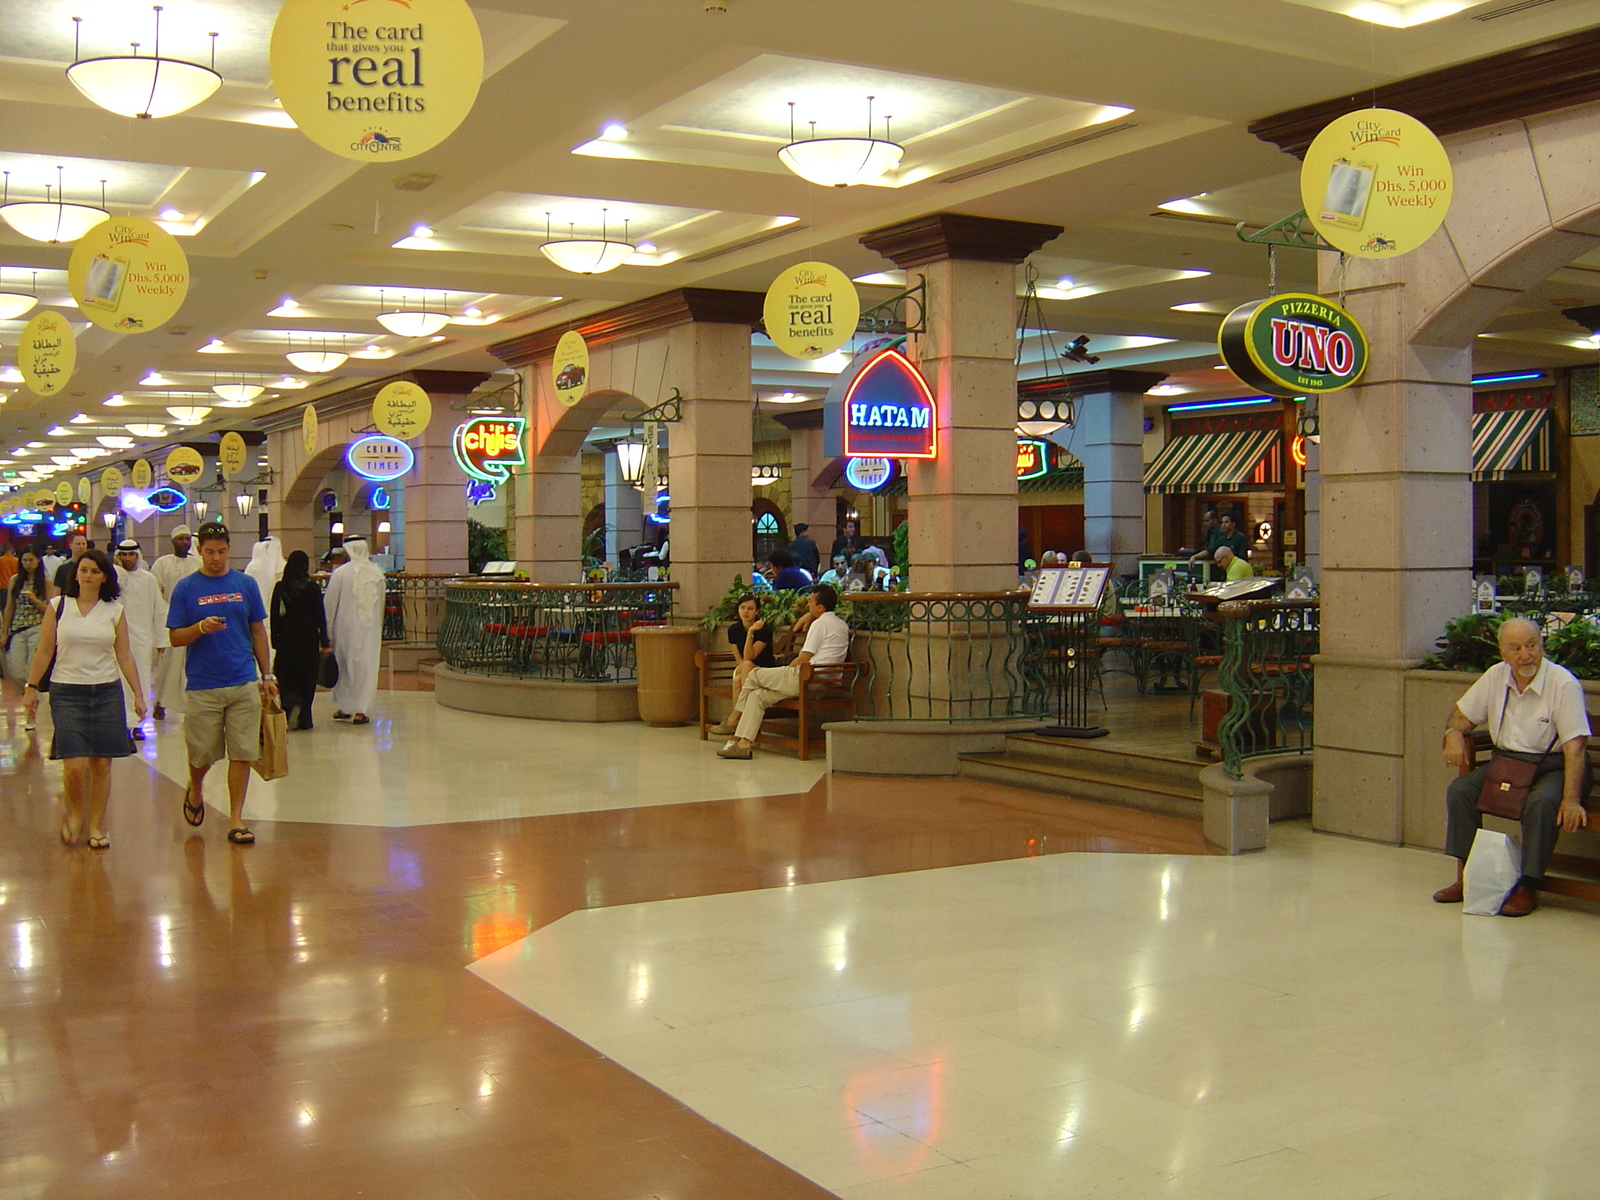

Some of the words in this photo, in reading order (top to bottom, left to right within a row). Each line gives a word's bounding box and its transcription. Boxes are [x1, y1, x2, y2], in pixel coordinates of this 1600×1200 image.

[326, 21, 367, 40] The
[375, 23, 423, 41] card
[326, 42, 349, 51] that
[352, 42, 380, 53] gives
[383, 44, 403, 54] you
[328, 47, 424, 86] real
[326, 91, 425, 112] benefits
[1357, 121, 1380, 131] City
[1350, 130, 1379, 142] Win
[1378, 128, 1401, 137] Card
[1397, 165, 1424, 176] Win
[1376, 180, 1406, 192] Dhs.
[1408, 179, 1447, 193] 5,000
[1386, 195, 1437, 208] Weekly
[114, 225, 133, 236] City
[109, 233, 131, 243] Win
[131, 232, 150, 240] Card
[145, 262, 167, 271] Win
[128, 273, 152, 283] Dhs.
[153, 273, 184, 284] 5,000
[137, 285, 176, 296] Weekly
[788, 294, 807, 304] The
[810, 293, 832, 303] card
[789, 305, 833, 325] real
[1281, 302, 1341, 327] PIZZERIA
[789, 326, 834, 338] benefits
[1271, 318, 1355, 377] UNO
[1297, 376, 1310, 385] EST
[850, 403, 930, 428] HATAM
[366, 445, 399, 453] CHINA
[366, 461, 399, 470] TIMES
